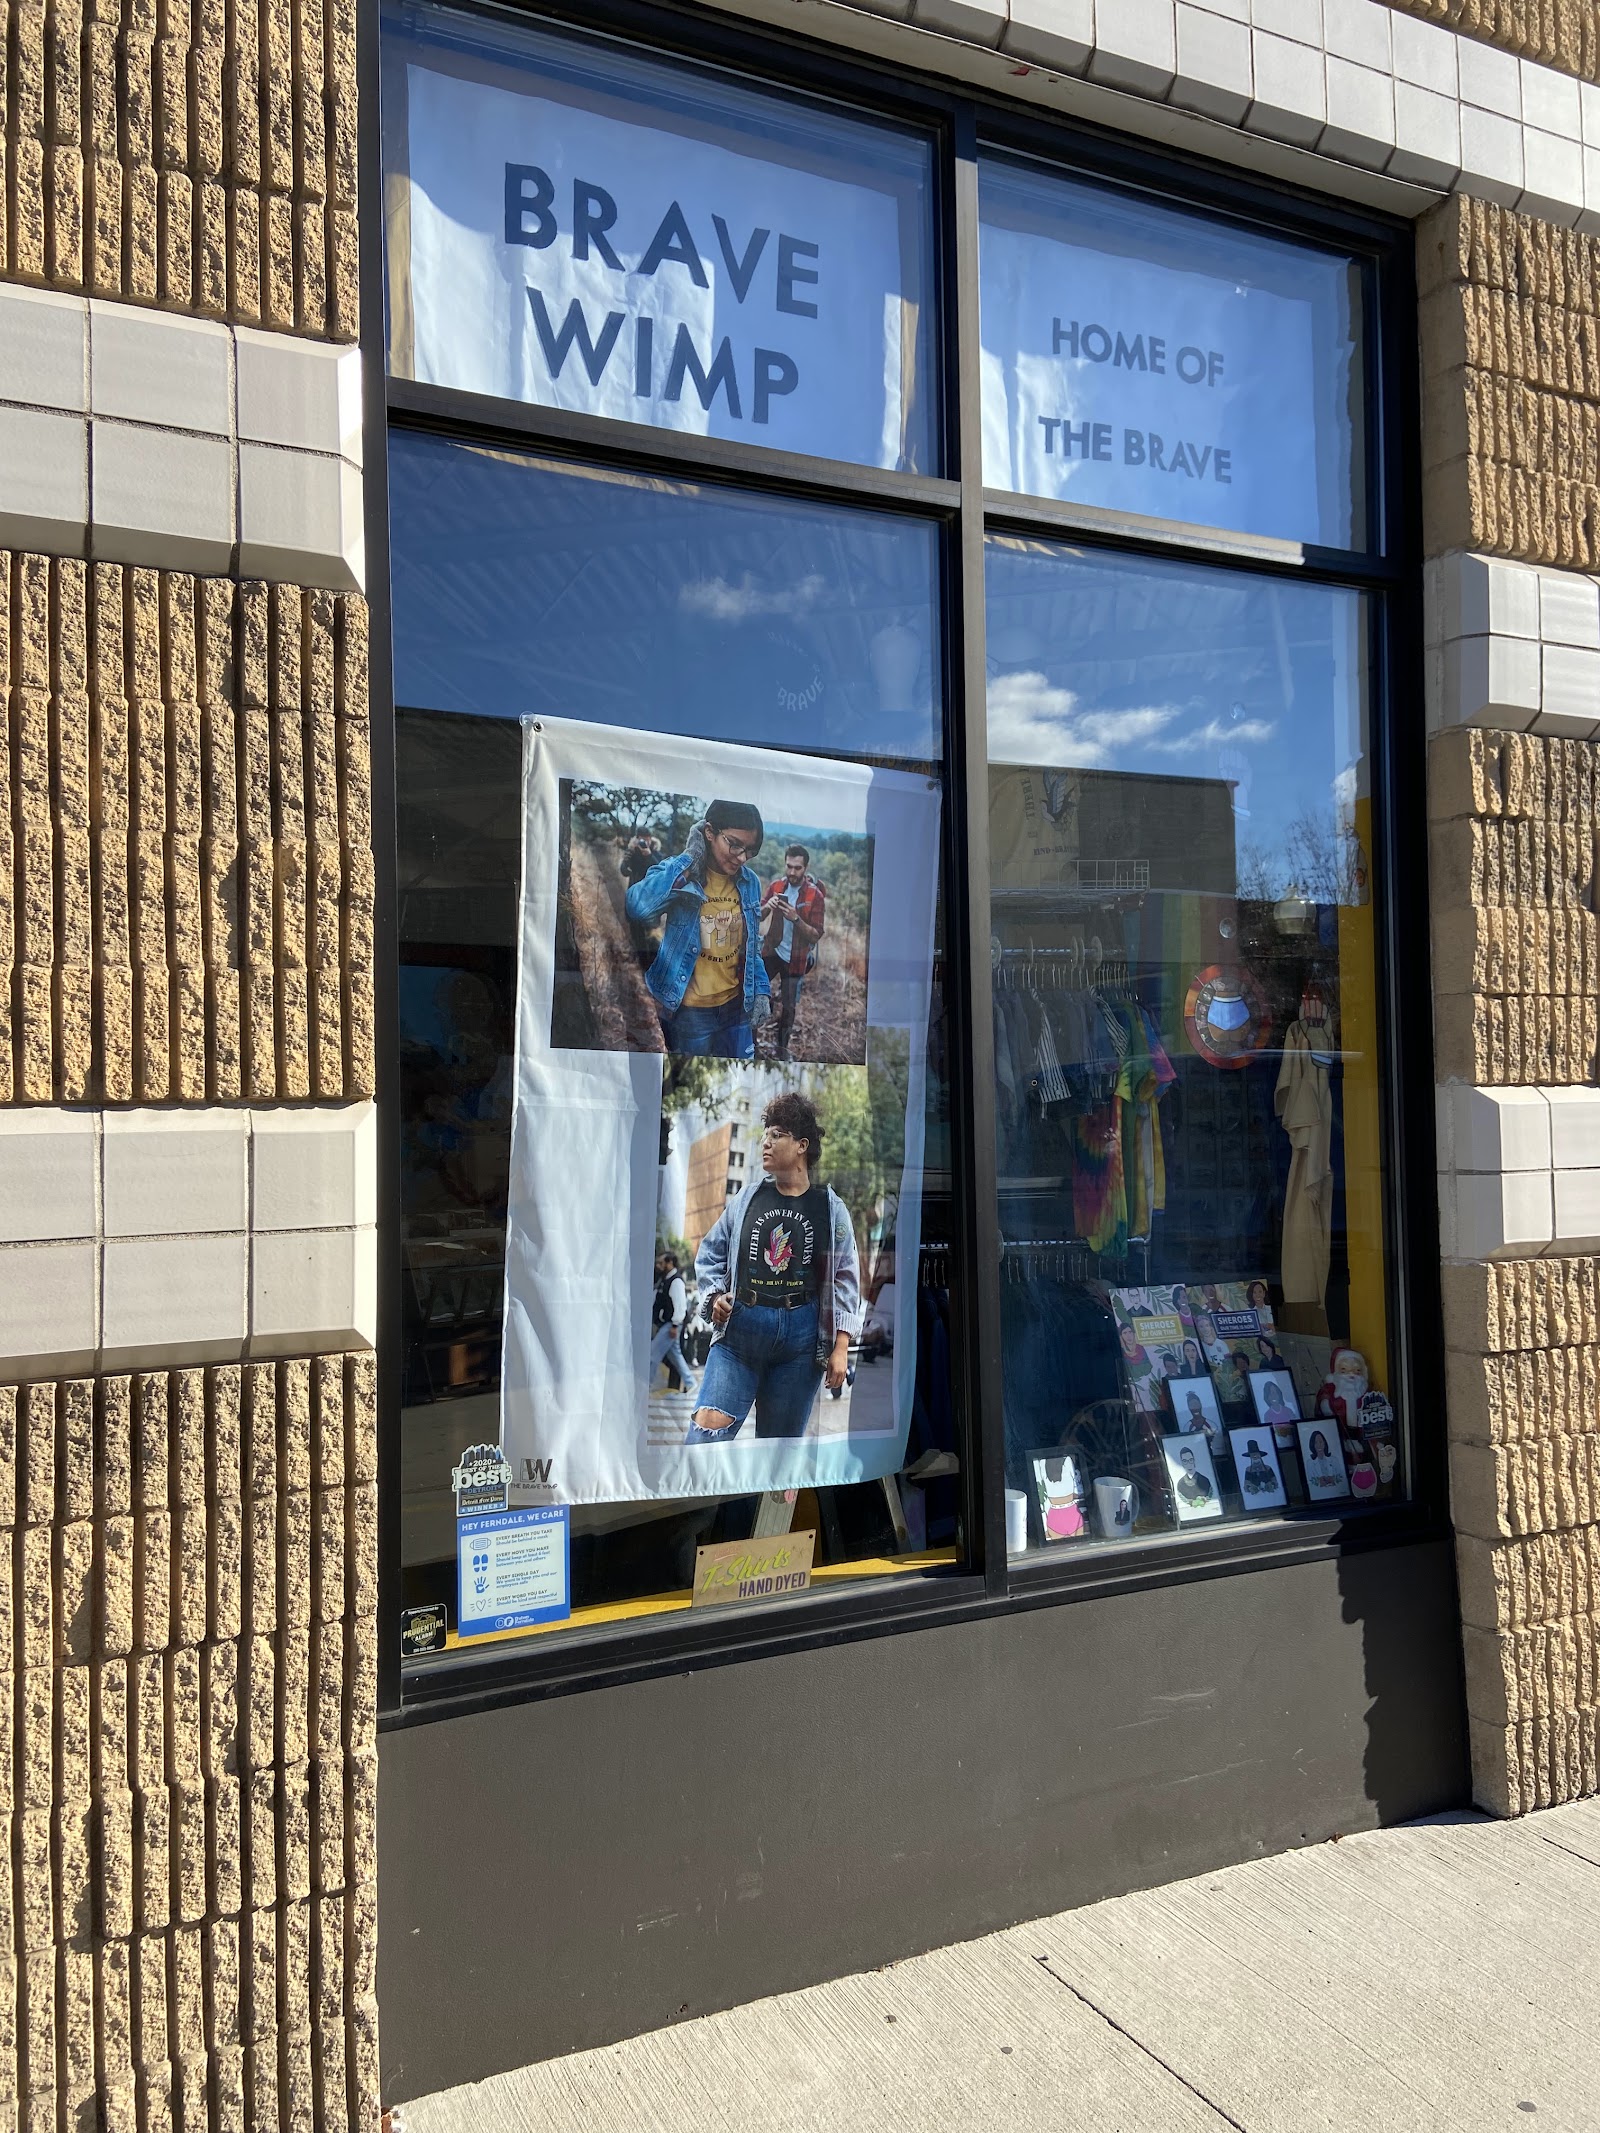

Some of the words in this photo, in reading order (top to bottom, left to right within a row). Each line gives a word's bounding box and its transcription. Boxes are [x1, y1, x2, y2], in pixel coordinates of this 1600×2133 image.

[505, 162, 819, 319] BRAVE
[526, 286, 799, 424] WIMP
[1052, 317, 1166, 374] HOME
[1176, 346, 1224, 387] OF
[1038, 415, 1112, 462] THE
[1124, 429, 1232, 484] BRAVE
[749, 1227, 761, 1261] THERE
[755, 1216, 765, 1226] IS
[764, 1208, 793, 1219] POWER
[794, 1212, 805, 1221] IN
[802, 1220, 814, 1265] KINDNESS
[1139, 1320, 1176, 1330] SHEROES
[1217, 1315, 1253, 1325] SHEROES
[1162, 1328, 1177, 1336] TIME
[1359, 1405, 1393, 1425] best
[473, 1459, 492, 1467] 2020
[454, 1463, 511, 1489] best
[467, 1485, 497, 1494] DETROIT
[467, 1503, 499, 1512] WINNER
[462, 1522, 479, 1531] HEY
[527, 1513, 540, 1521] WE
[541, 1510, 564, 1519] CARE
[701, 1547, 791, 1594] T-Shirts
[739, 1577, 773, 1597] HAND
[775, 1571, 806, 1592] DYED
[403, 1619, 445, 1640] PRUDENTIAL
[415, 1631, 434, 1641] ALARM
